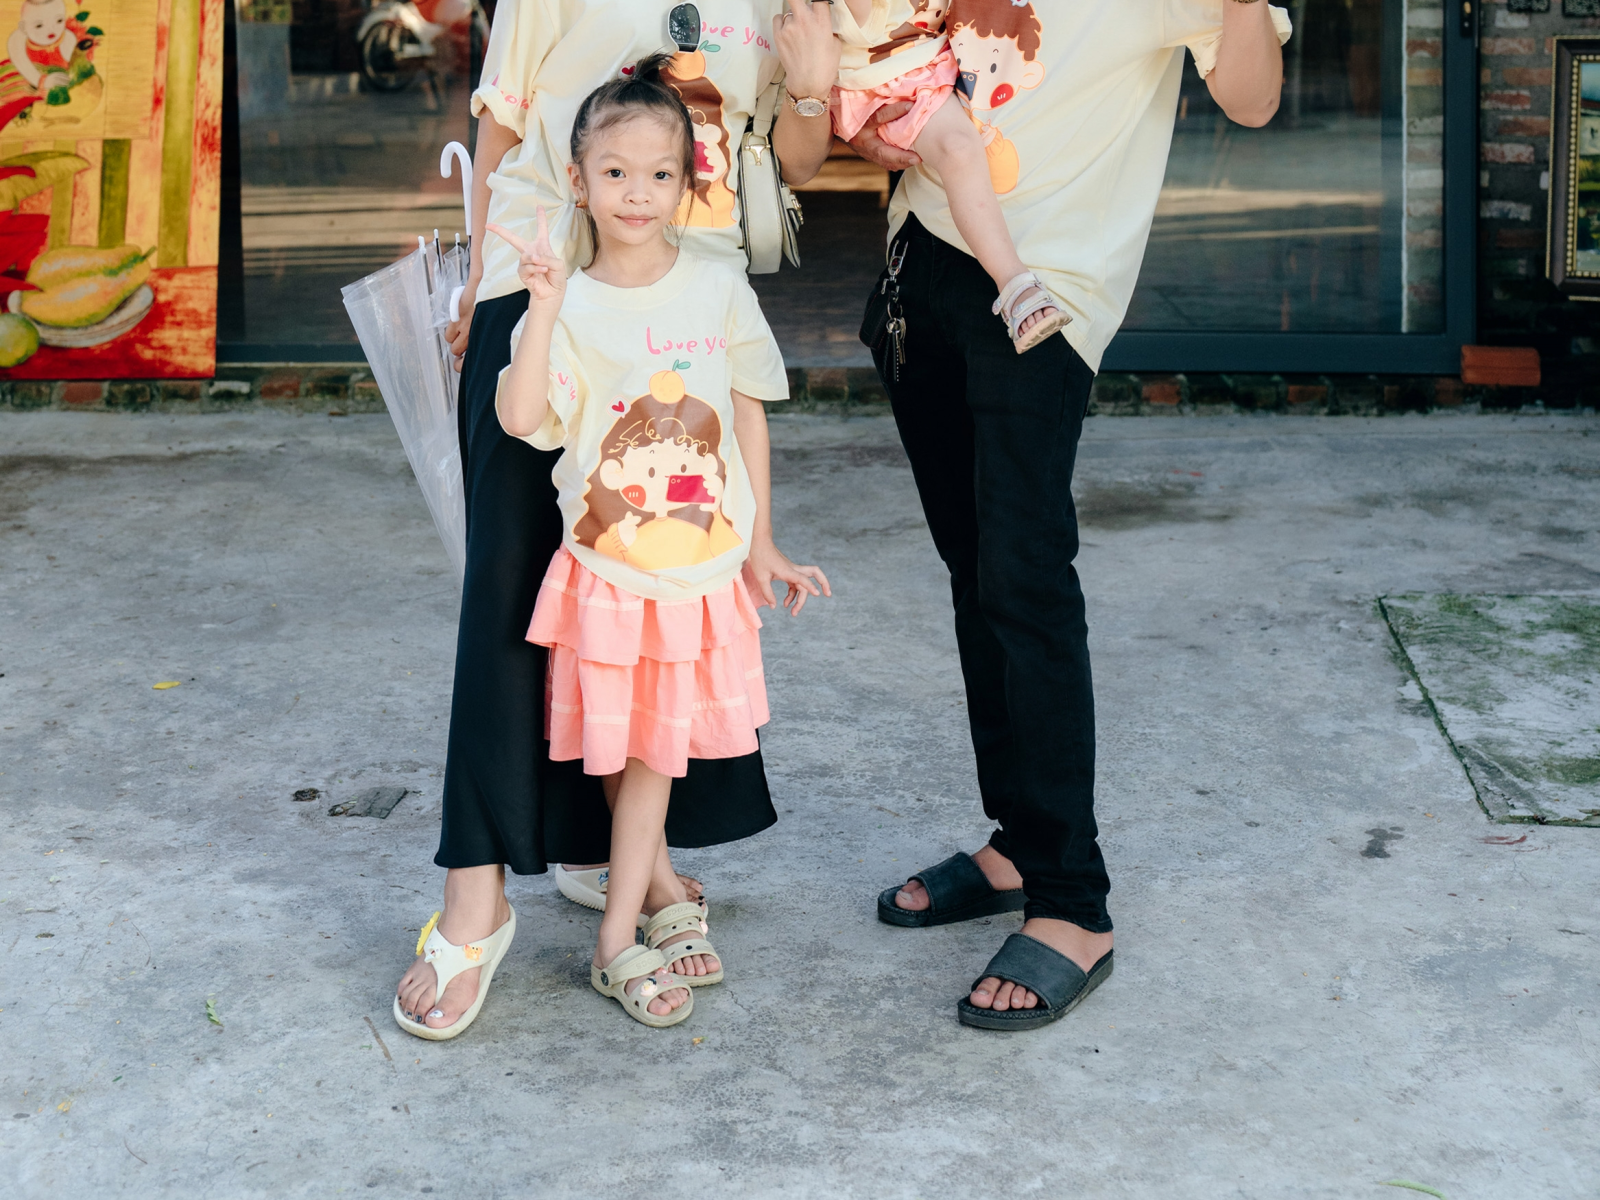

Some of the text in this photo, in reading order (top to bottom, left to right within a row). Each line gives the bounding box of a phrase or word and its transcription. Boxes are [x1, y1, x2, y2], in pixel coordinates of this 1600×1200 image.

[701, 20, 735, 38] ove
[646, 326, 727, 356] Love yo
